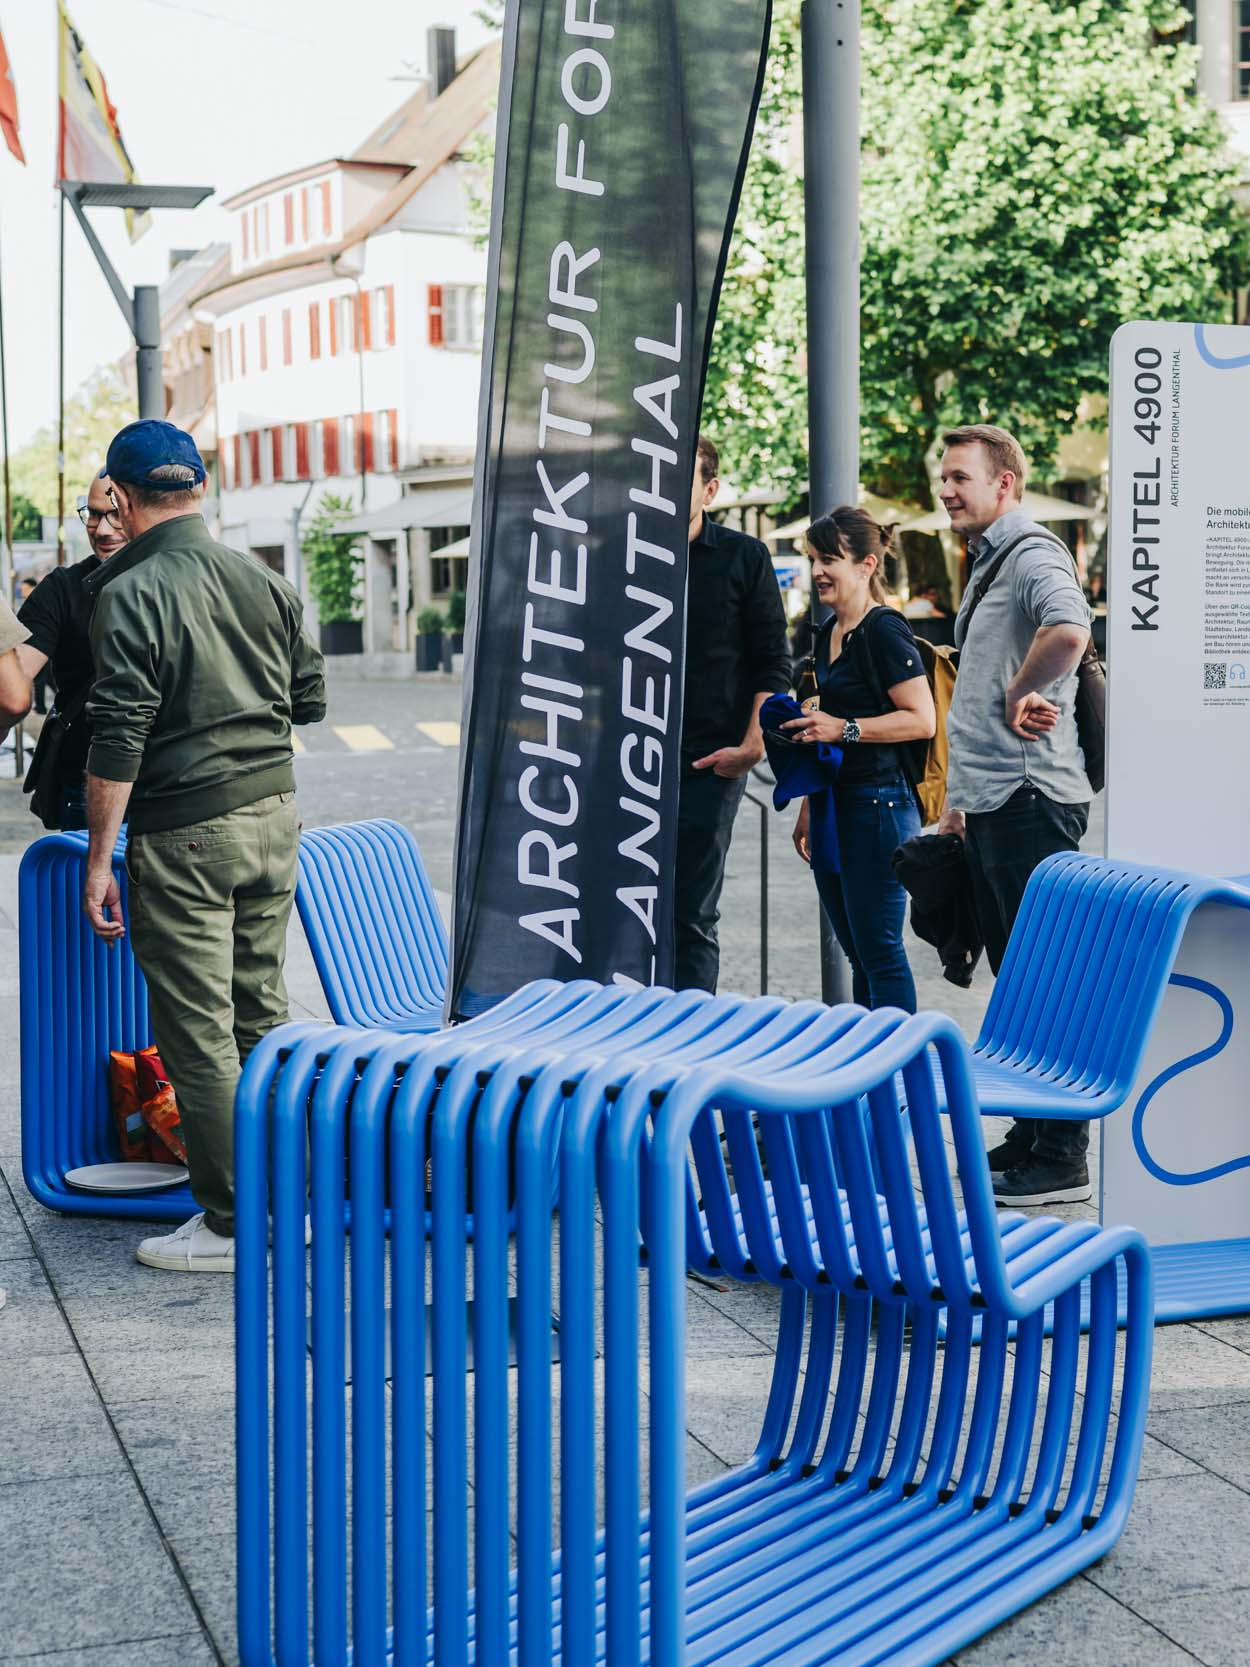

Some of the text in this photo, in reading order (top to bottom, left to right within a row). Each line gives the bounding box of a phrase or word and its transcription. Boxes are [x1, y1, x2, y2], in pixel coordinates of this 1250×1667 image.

[1131, 347, 1162, 631] KAPITEL 4900
[1170, 349, 1181, 507] ARCHITEKTUR FORUM LANGENTHAL
[1206, 506, 1222, 516] Die
[518, 241, 600, 964] ARCHITEKTUR
[612, 302, 682, 990] LANGENTHAL
